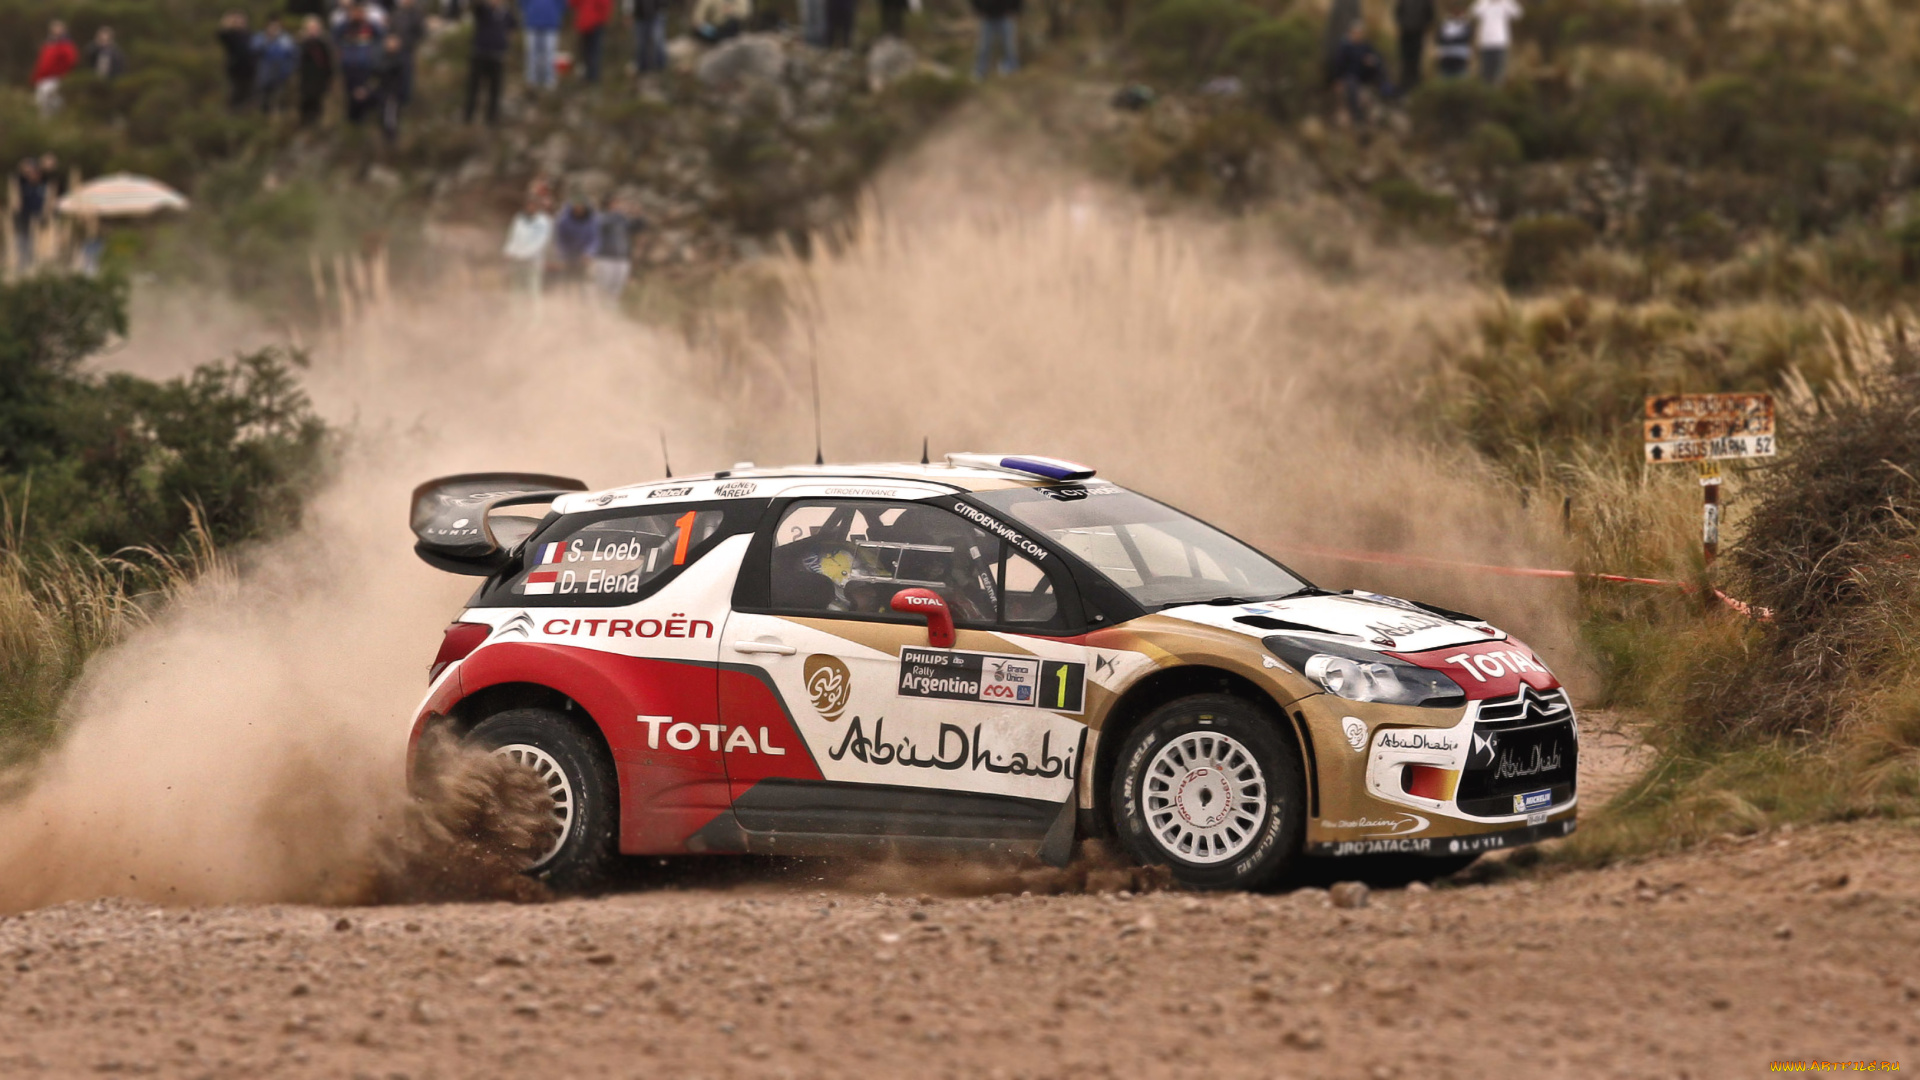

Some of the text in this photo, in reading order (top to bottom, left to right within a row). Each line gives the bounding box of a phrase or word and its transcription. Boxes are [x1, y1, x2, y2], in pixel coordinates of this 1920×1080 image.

[1755, 437, 1771, 454] 52
[861, 489, 898, 497] FINANCE
[427, 528, 478, 536] LUHTA
[672, 510, 697, 565] 1
[954, 502, 1048, 560] CITROEN-WRC.COM
[567, 537, 641, 562] S. Loeb
[559, 569, 640, 594] D. Elena
[904, 596, 943, 606] TOTAL
[904, 652, 948, 665] PHILIPS
[912, 665, 934, 677] Rally
[901, 673, 978, 695] Argentina
[983, 684, 1014, 698] ACA
[1056, 664, 1068, 707] 1
[637, 715, 785, 756] TOTAL
